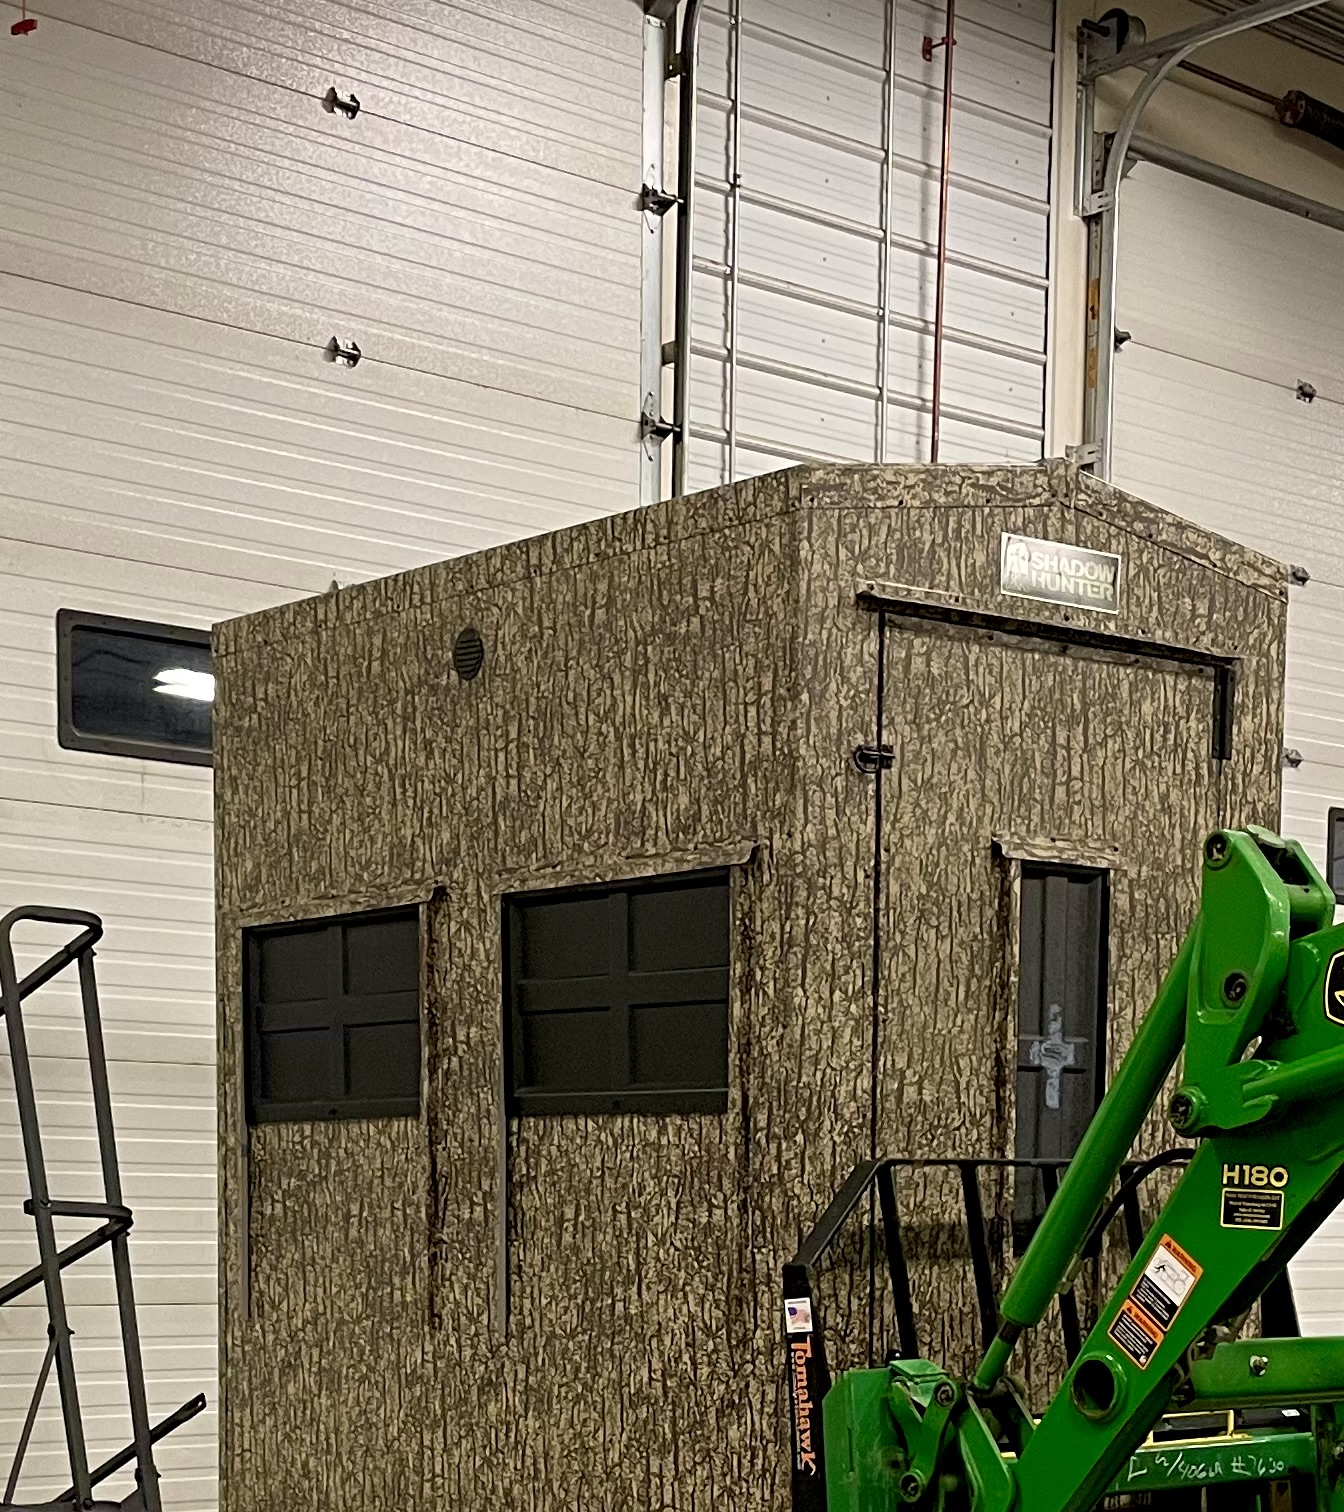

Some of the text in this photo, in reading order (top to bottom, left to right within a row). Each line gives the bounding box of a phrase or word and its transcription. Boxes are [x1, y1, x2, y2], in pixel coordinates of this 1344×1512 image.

[1031, 551, 1116, 583] SHADOW
[1031, 571, 1114, 602] HUNTER
[1222, 1163, 1289, 1188] H180
